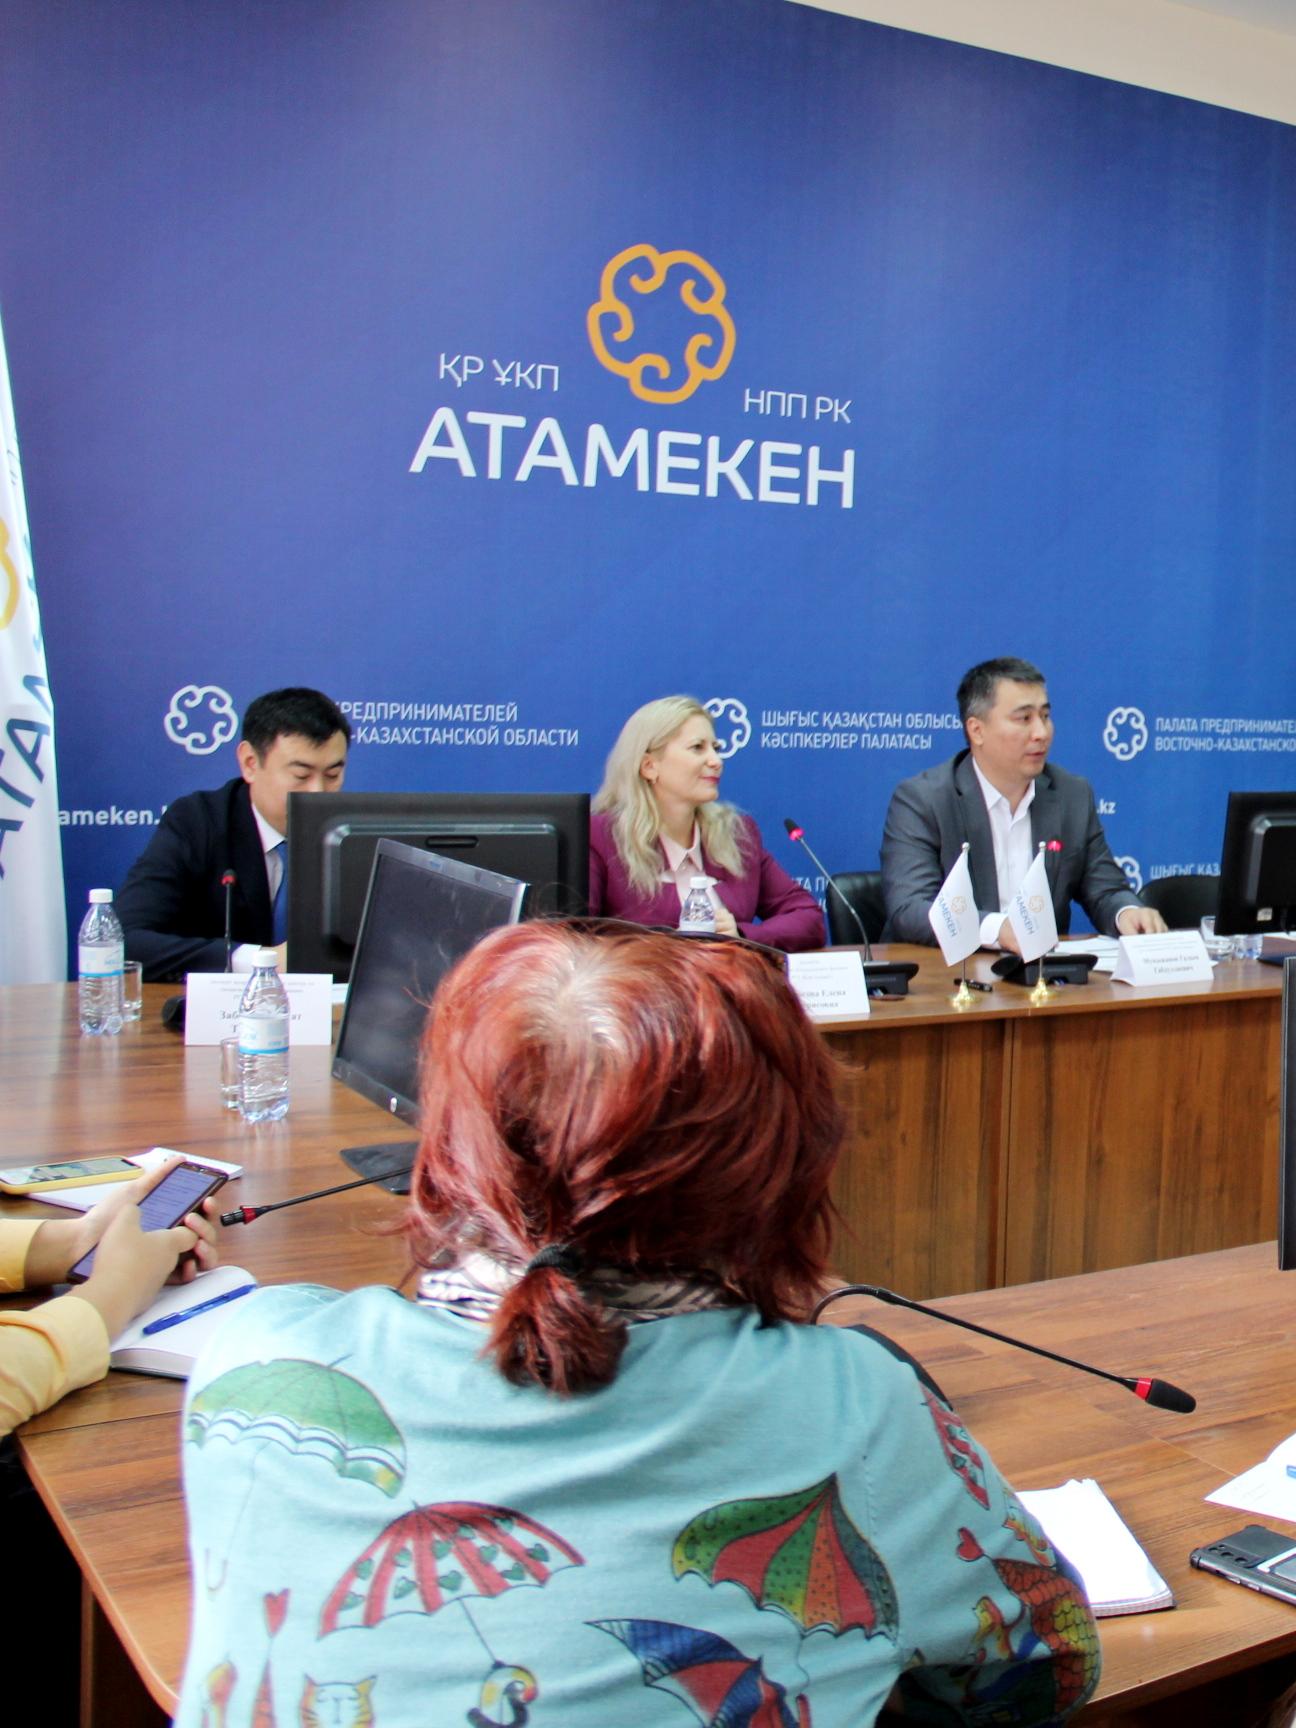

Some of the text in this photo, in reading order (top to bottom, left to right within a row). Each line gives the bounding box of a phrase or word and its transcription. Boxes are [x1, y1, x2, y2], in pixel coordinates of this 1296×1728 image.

[438, 352, 484, 388] ҚР
[743, 388, 852, 425] НПП РК
[408, 405, 856, 510] АТАМЕКЕН
[761, 710, 820, 728] ШЫҒЫС
[821, 711, 903, 731] ҚАЗАҚСТАН
[1155, 717, 1198, 733] ПАЛАТА
[350, 724, 579, 747] -КАЗАХСТАНСКОЙ ОБЛАСТИ
[860, 732, 932, 750] ПАЛАТАСЫ
[58, 804, 168, 826] ameken.
